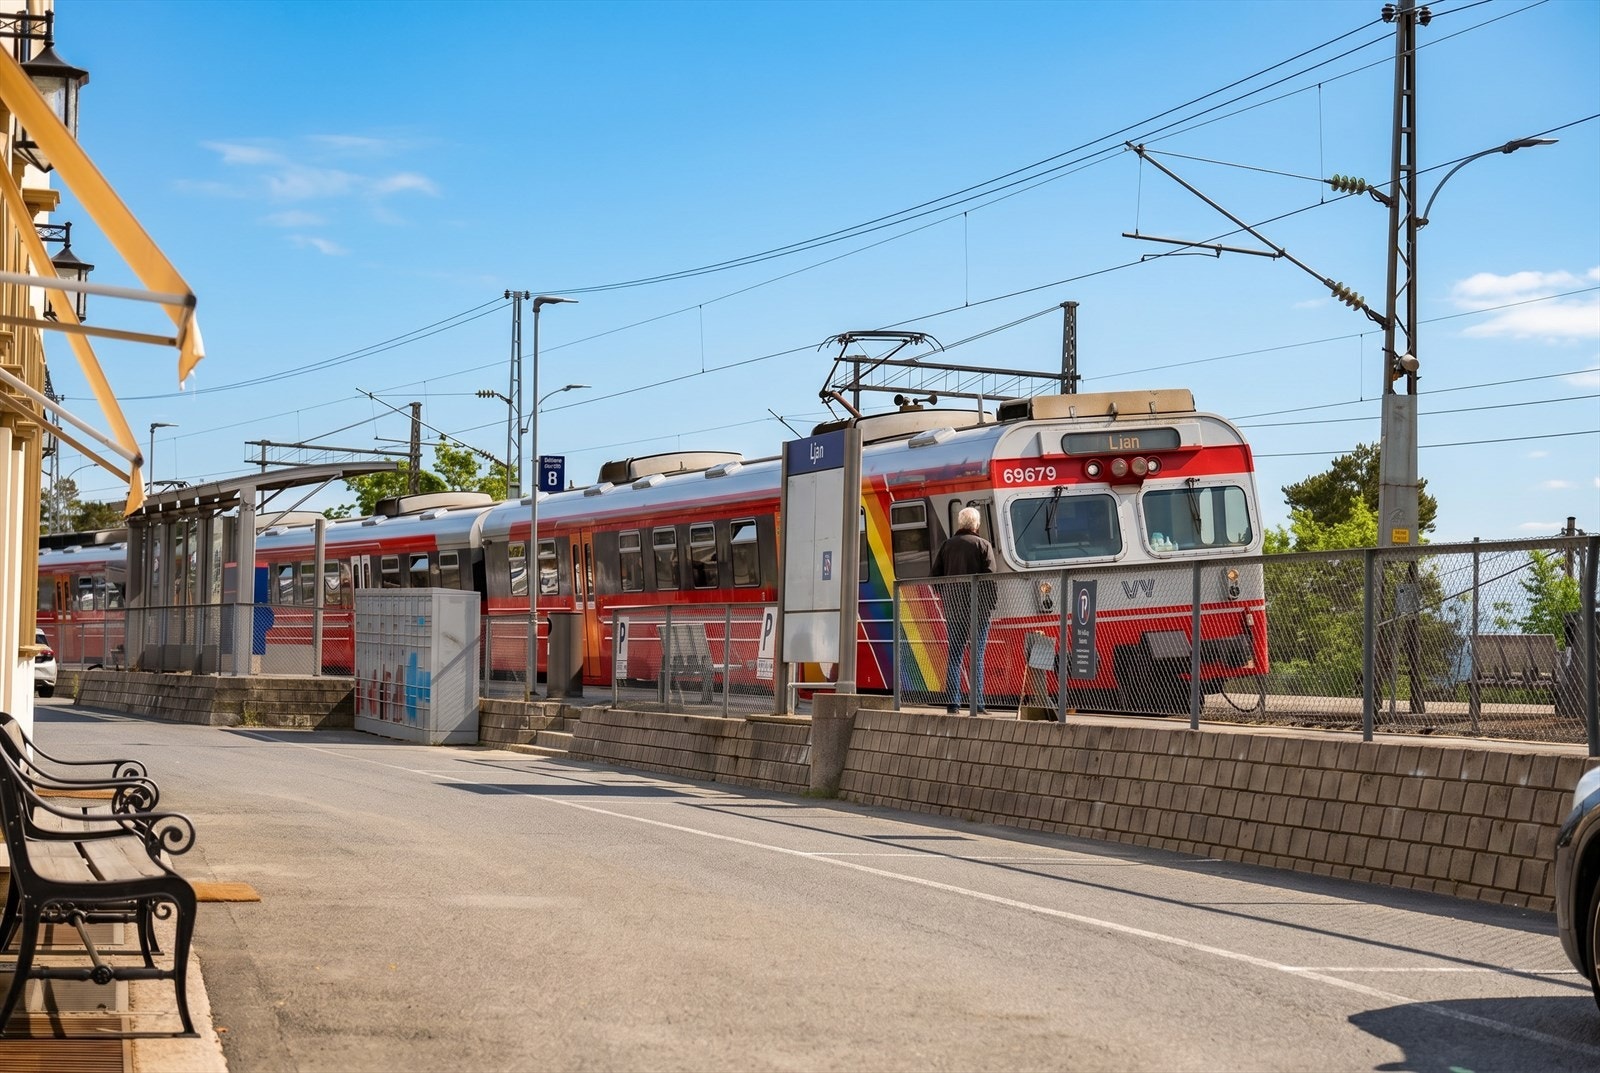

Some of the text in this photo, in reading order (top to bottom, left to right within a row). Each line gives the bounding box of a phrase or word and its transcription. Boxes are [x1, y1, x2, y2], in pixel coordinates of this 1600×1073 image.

[1109, 434, 1140, 450] Lian
[810, 442, 824, 465] Ljan
[548, 471, 557, 486] 8
[1003, 466, 1057, 484] 69679
[619, 622, 626, 654] P
[762, 613, 773, 651] P
